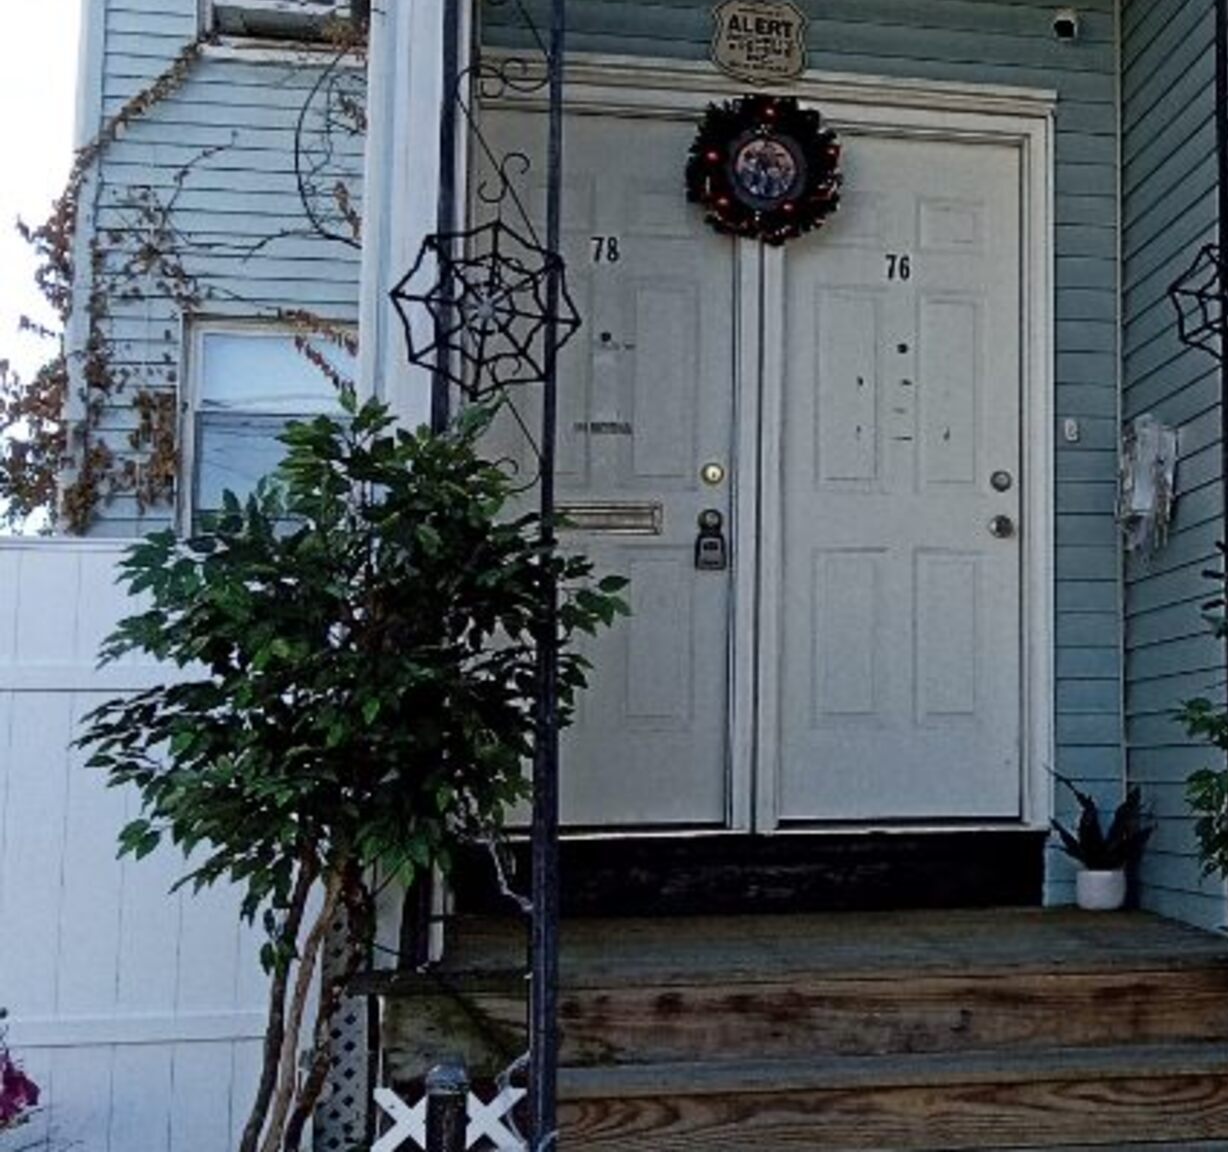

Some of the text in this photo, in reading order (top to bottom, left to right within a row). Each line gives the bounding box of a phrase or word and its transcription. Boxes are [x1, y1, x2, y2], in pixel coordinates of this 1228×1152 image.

[728, 14, 794, 38] ALERT
[591, 236, 620, 263] 78
[885, 255, 911, 281] 76
